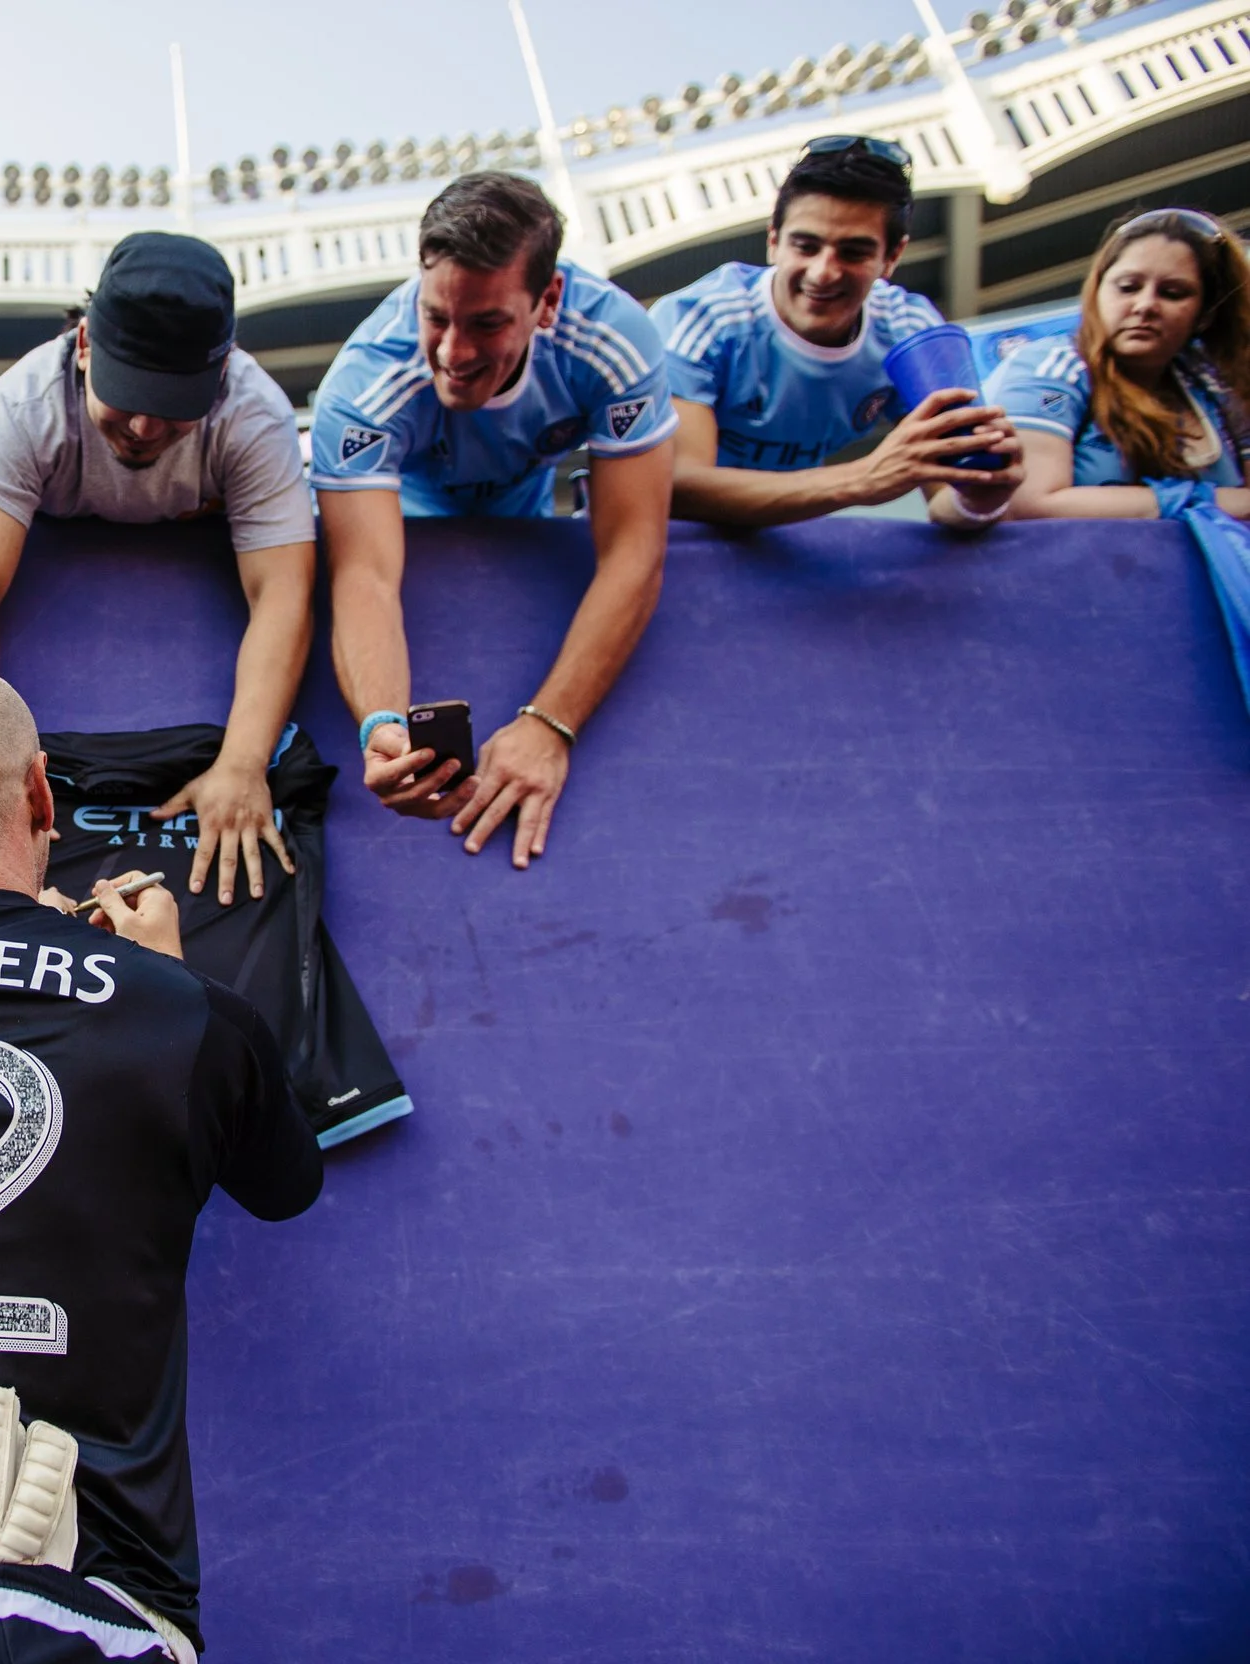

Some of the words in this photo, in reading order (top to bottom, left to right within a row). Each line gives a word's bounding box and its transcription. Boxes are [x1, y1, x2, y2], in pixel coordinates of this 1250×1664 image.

[718, 428, 822, 466] ETIH
[73, 805, 283, 833] ETIH
[108, 832, 201, 849] AIRW
